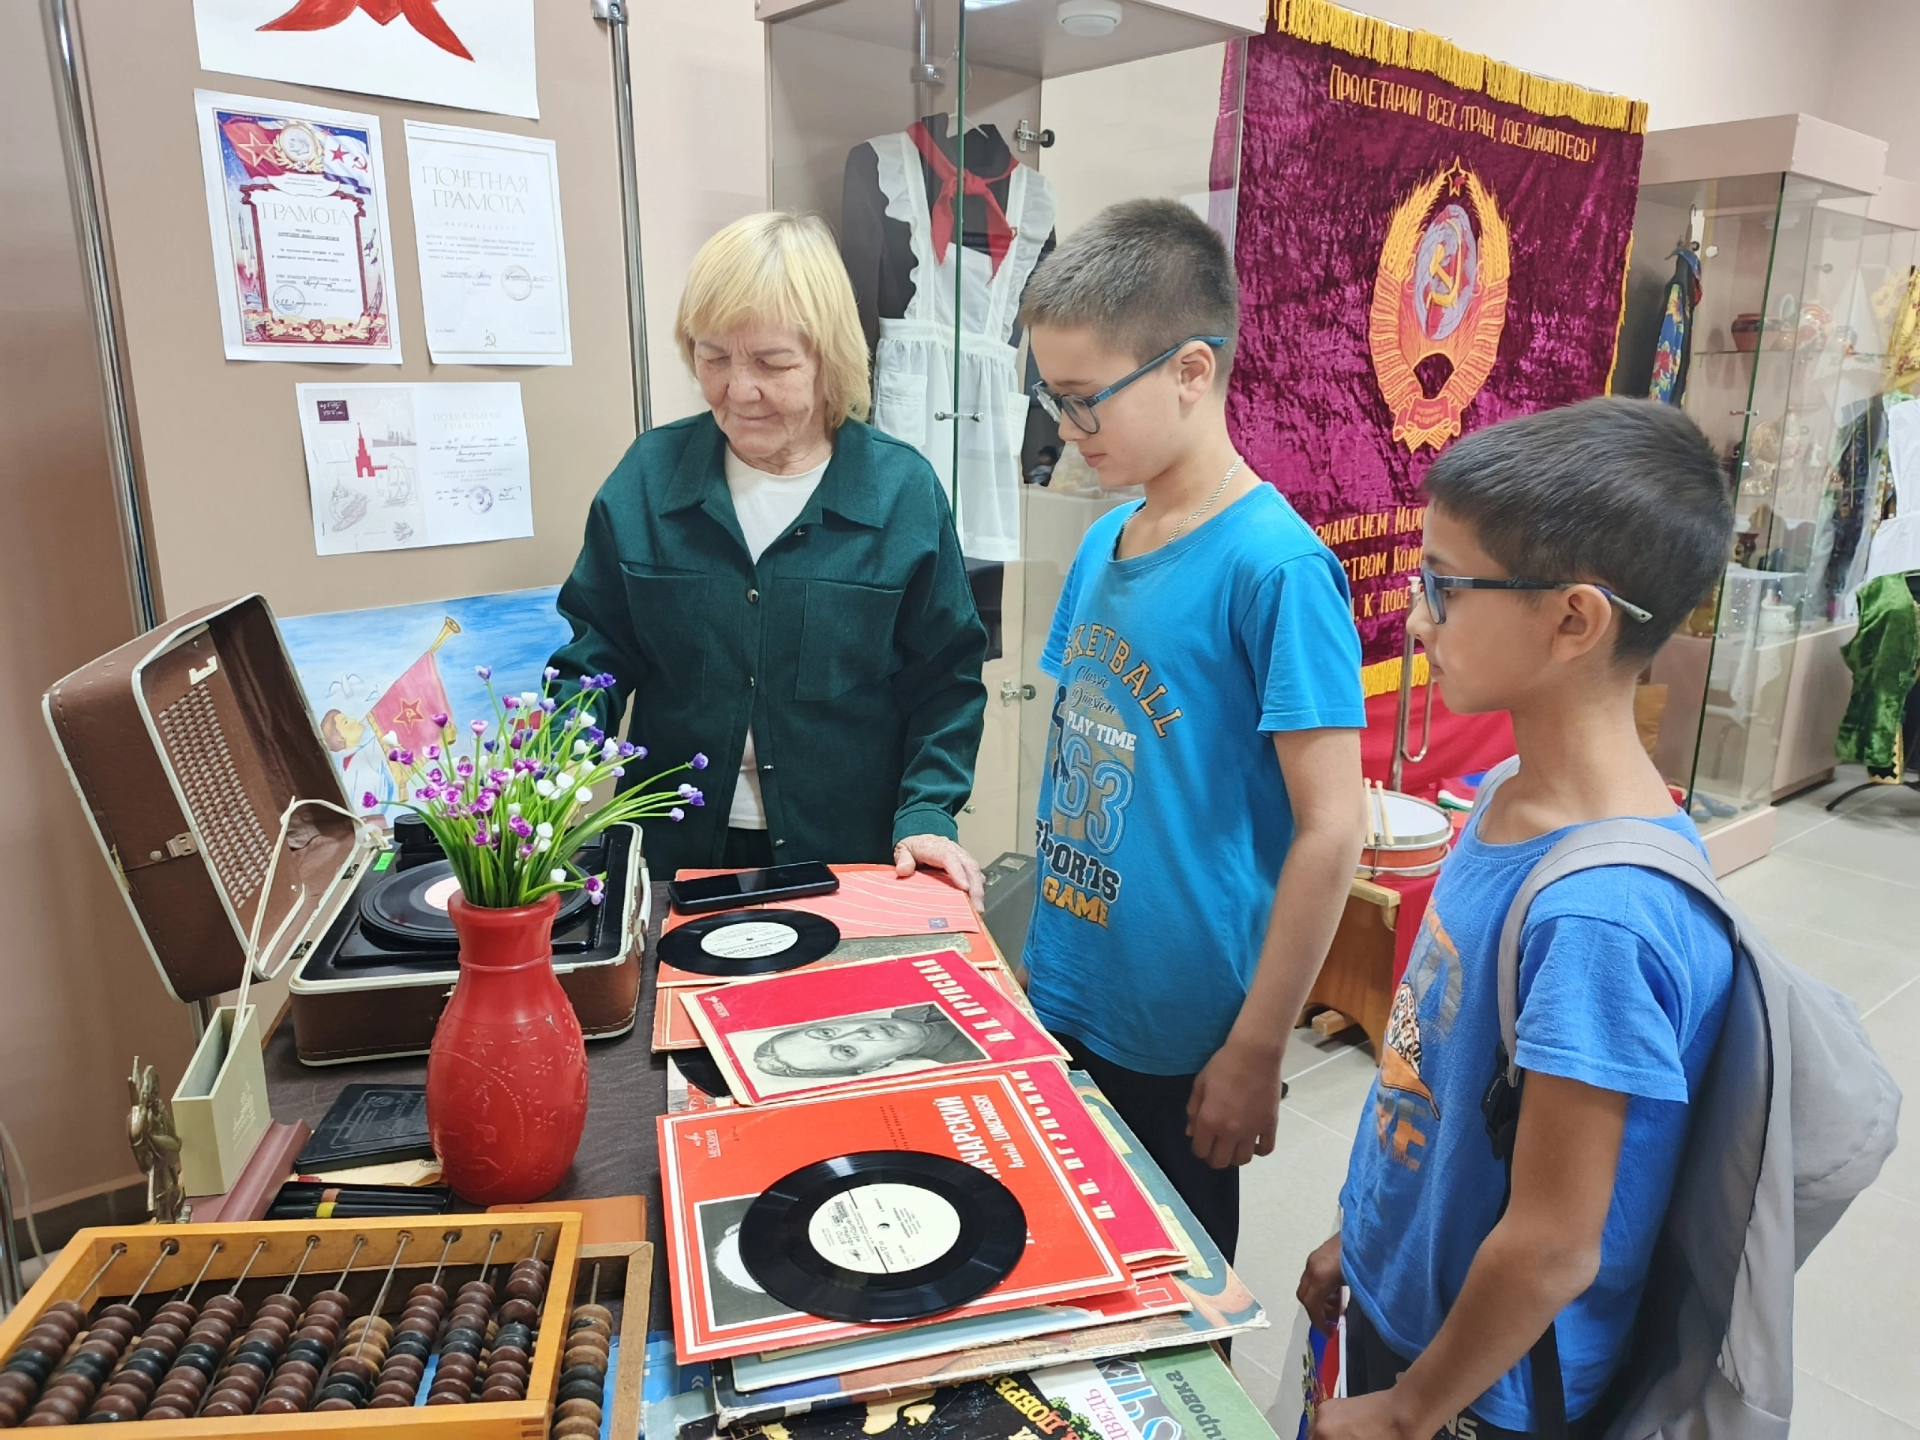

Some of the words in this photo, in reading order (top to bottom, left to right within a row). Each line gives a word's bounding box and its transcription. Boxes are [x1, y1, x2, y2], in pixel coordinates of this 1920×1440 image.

[1329, 64, 1423, 118] ПРОЛЕТАРИИ
[1426, 92, 1456, 130] ВСЕХ
[1500, 117, 1598, 164] СОЕДИНЯЙТЕСЬ!
[421, 165, 529, 193] ПОЧЕТНАЯ
[261, 201, 352, 227] ГРАМОТА
[432, 189, 526, 215] ГРАМОТА
[1074, 665, 1111, 690] Classic
[1070, 686, 1121, 716] Division
[1066, 709, 1095, 738] PLAY
[1096, 722, 1138, 752] TIME
[1054, 733, 1136, 856] 63
[1042, 875, 1110, 931] GAME
[911, 958, 989, 1017] КРУПСКАЯ
[1165, 1369, 1227, 1440] ировка
